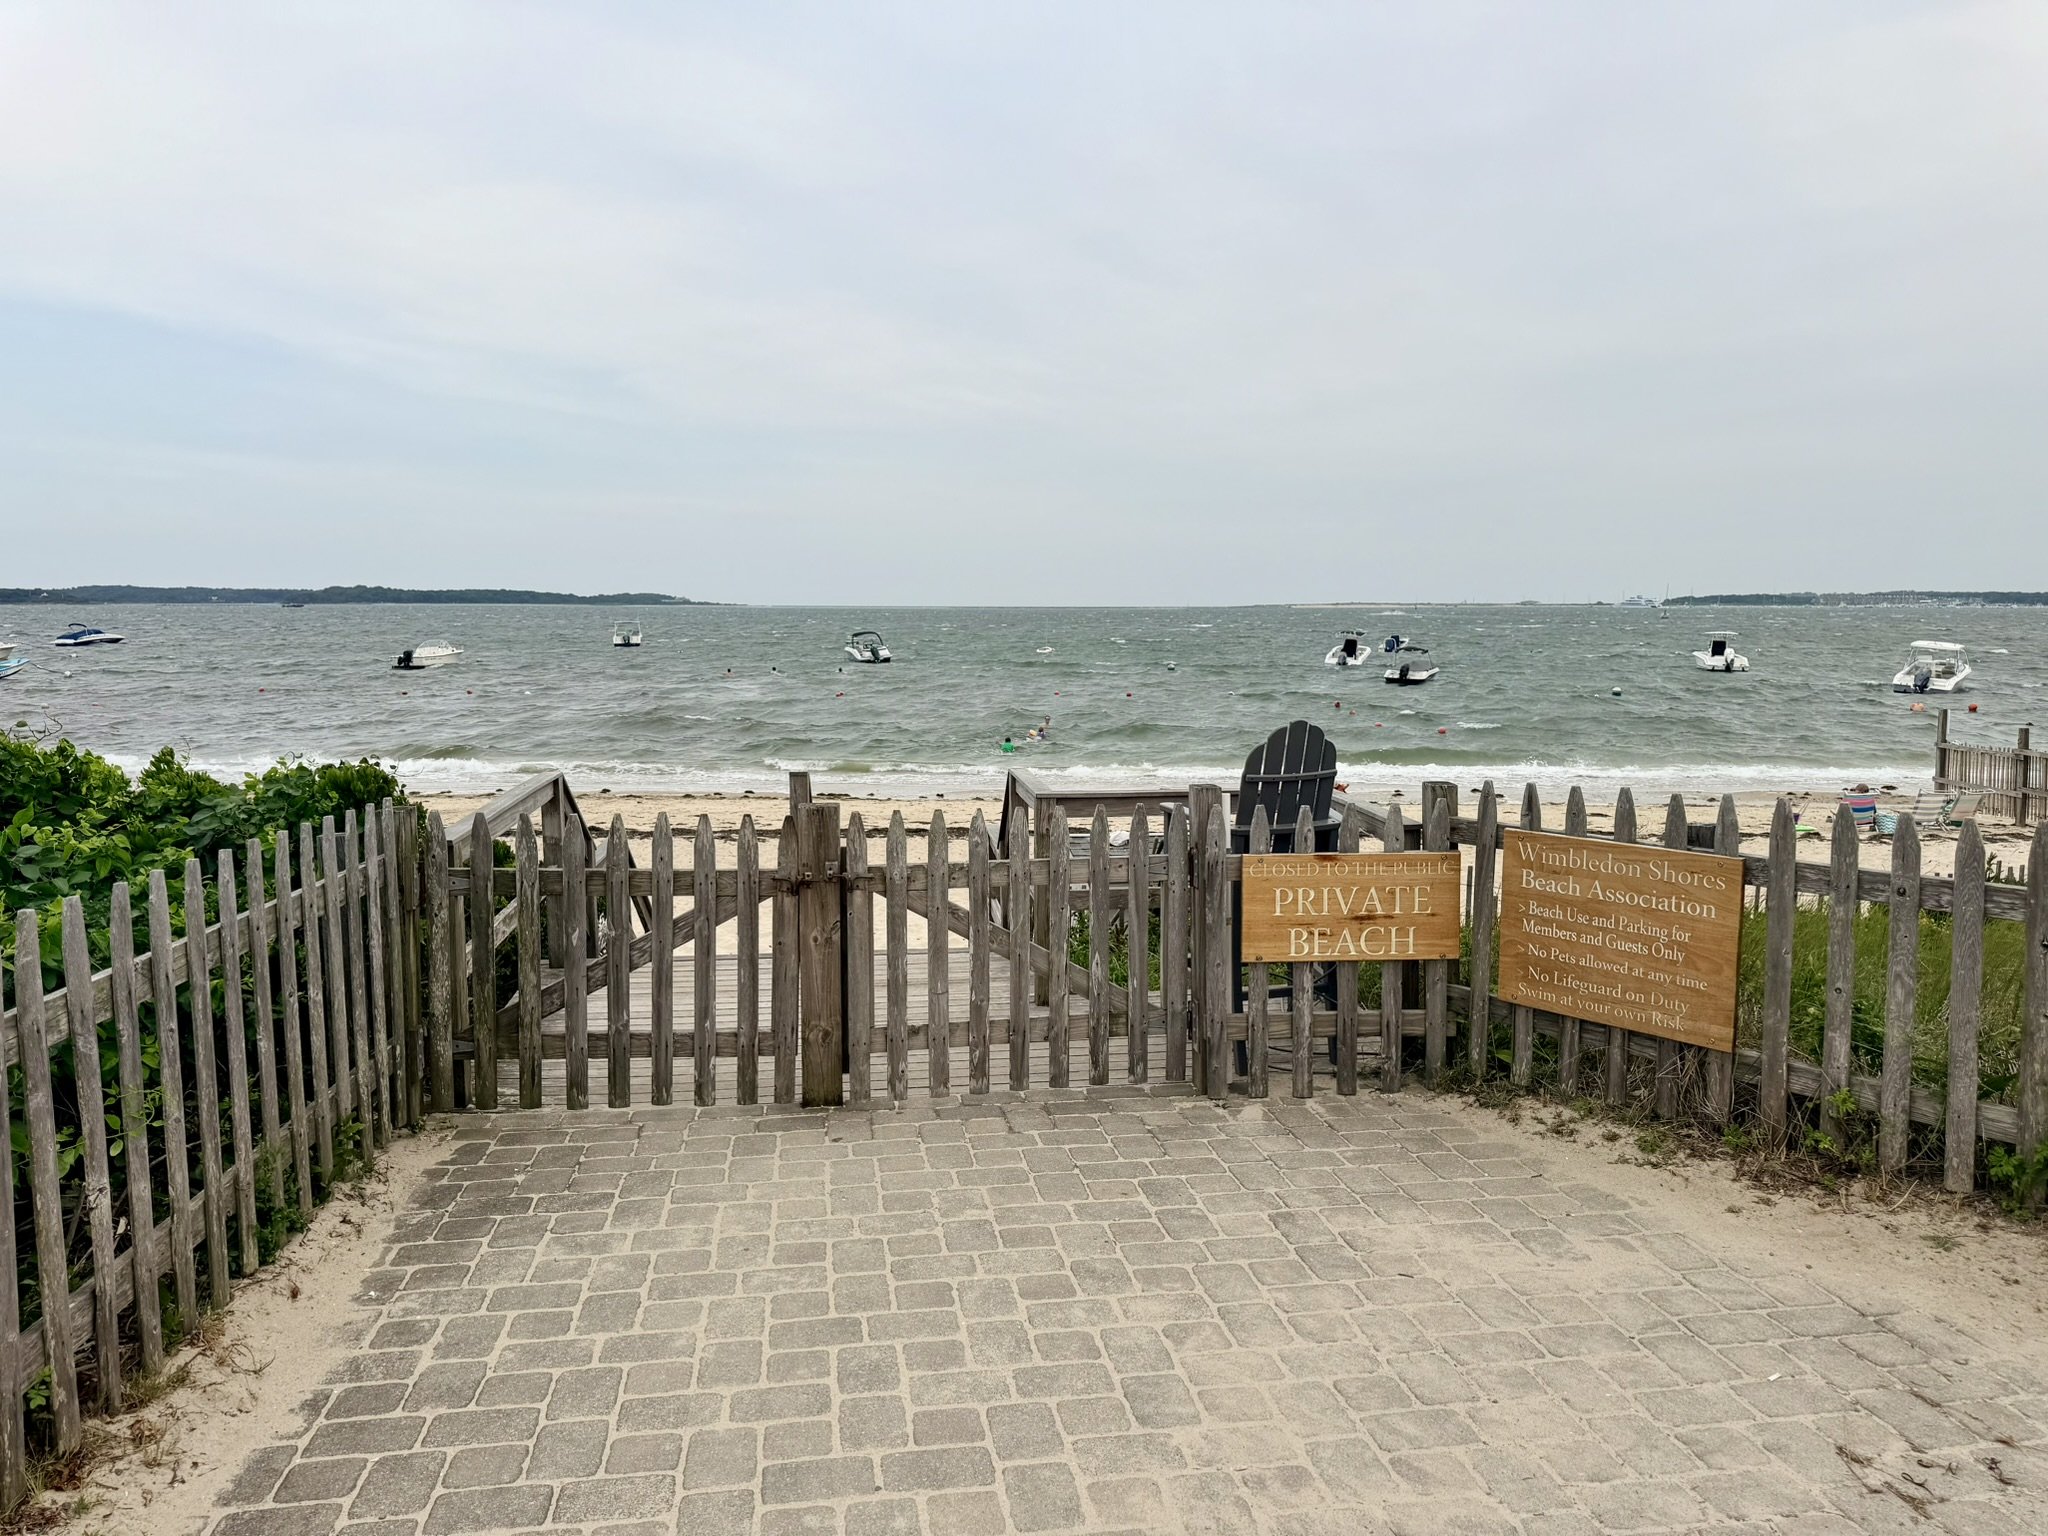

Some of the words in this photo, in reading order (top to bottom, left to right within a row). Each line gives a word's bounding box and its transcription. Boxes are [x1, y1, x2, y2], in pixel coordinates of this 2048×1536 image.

[1250, 862, 1319, 877] CLOSED
[1327, 862, 1348, 876] TO
[1351, 861, 1389, 876] THE
[1393, 861, 1455, 875] PUBLIC
[1518, 841, 1641, 878] Wimbledon
[1648, 859, 1726, 890] Shores
[1272, 886, 1432, 916] PRIVATE
[1521, 869, 1581, 897] Beach
[1588, 880, 1716, 919] Association
[1288, 926, 1416, 956] BEACH
[1523, 919, 1577, 942] Members
[1580, 931, 1602, 947] and
[1606, 934, 1648, 955] Guests
[1652, 942, 1685, 966] Only
[1529, 901, 1563, 921] Beach
[1567, 908, 1589, 924] Use
[1592, 914, 1615, 930] and
[1619, 916, 1668, 942] Parking
[1672, 925, 1691, 942] for
[1528, 943, 1546, 958] No
[1551, 948, 1576, 964] Pets
[1579, 954, 1628, 974] allowed
[1632, 964, 1644, 977] at
[1648, 971, 1673, 986] any
[1676, 975, 1708, 990] time
[1518, 982, 1556, 1002] Swim
[1560, 993, 1572, 1006] at
[1576, 999, 1610, 1014] your
[1615, 1008, 1646, 1022] own
[1652, 1011, 1685, 1031] Risk
[1528, 966, 1549, 982] No
[1554, 972, 1621, 998] Lifeguard
[1626, 991, 1645, 1003] on
[1650, 992, 1689, 1015] Duty
